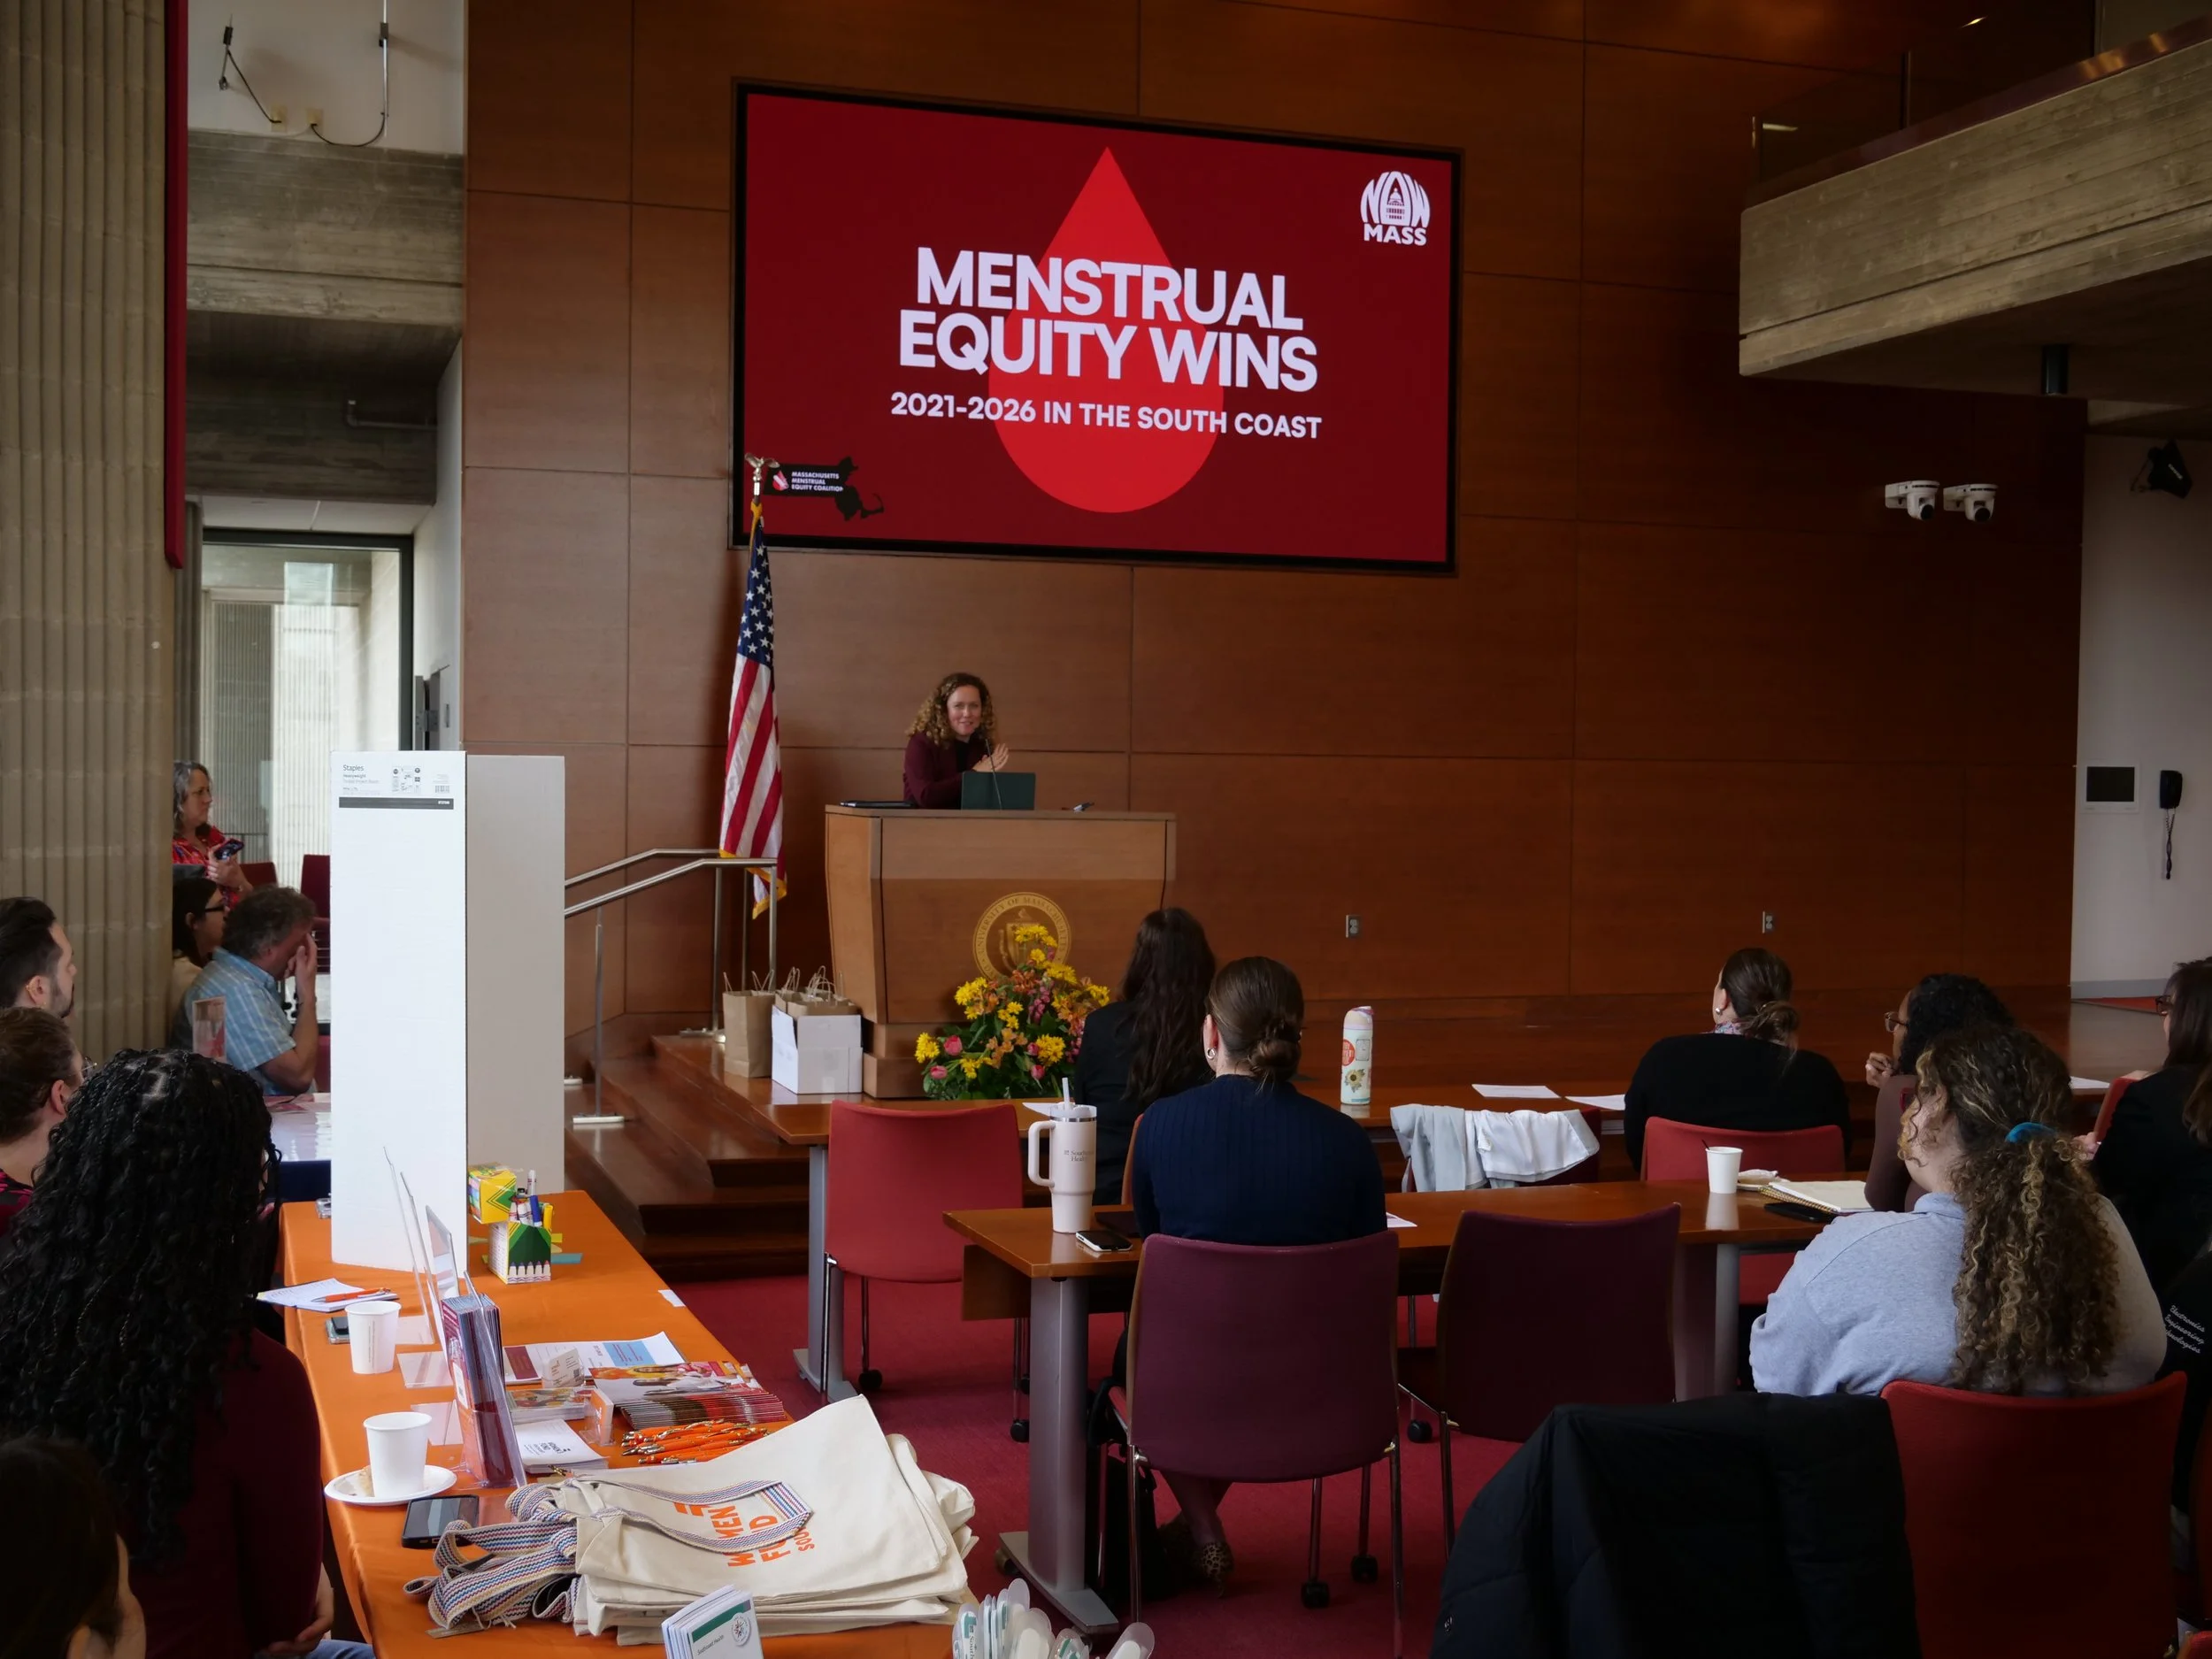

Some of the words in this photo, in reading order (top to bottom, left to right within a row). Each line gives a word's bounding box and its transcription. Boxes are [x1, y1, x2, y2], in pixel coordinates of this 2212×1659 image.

[1363, 223, 1427, 246] MASS
[917, 246, 1304, 331] MENSTRUAL
[899, 309, 1139, 380] EQUITY
[1148, 326, 1318, 392] WINS
[891, 391, 1037, 423] 2021-2026
[1043, 400, 1071, 425] IN
[1079, 403, 1131, 428] THE
[1137, 406, 1228, 434] SOUTH
[1234, 412, 1323, 439] COAST
[791, 471, 840, 480] MASSACHUSETTS
[2164, 1314, 2205, 1345] Engineering
[2170, 1304, 2206, 1333] Electronics
[708, 1505, 756, 1567] WMEN
[749, 1515, 792, 1563] FUD
